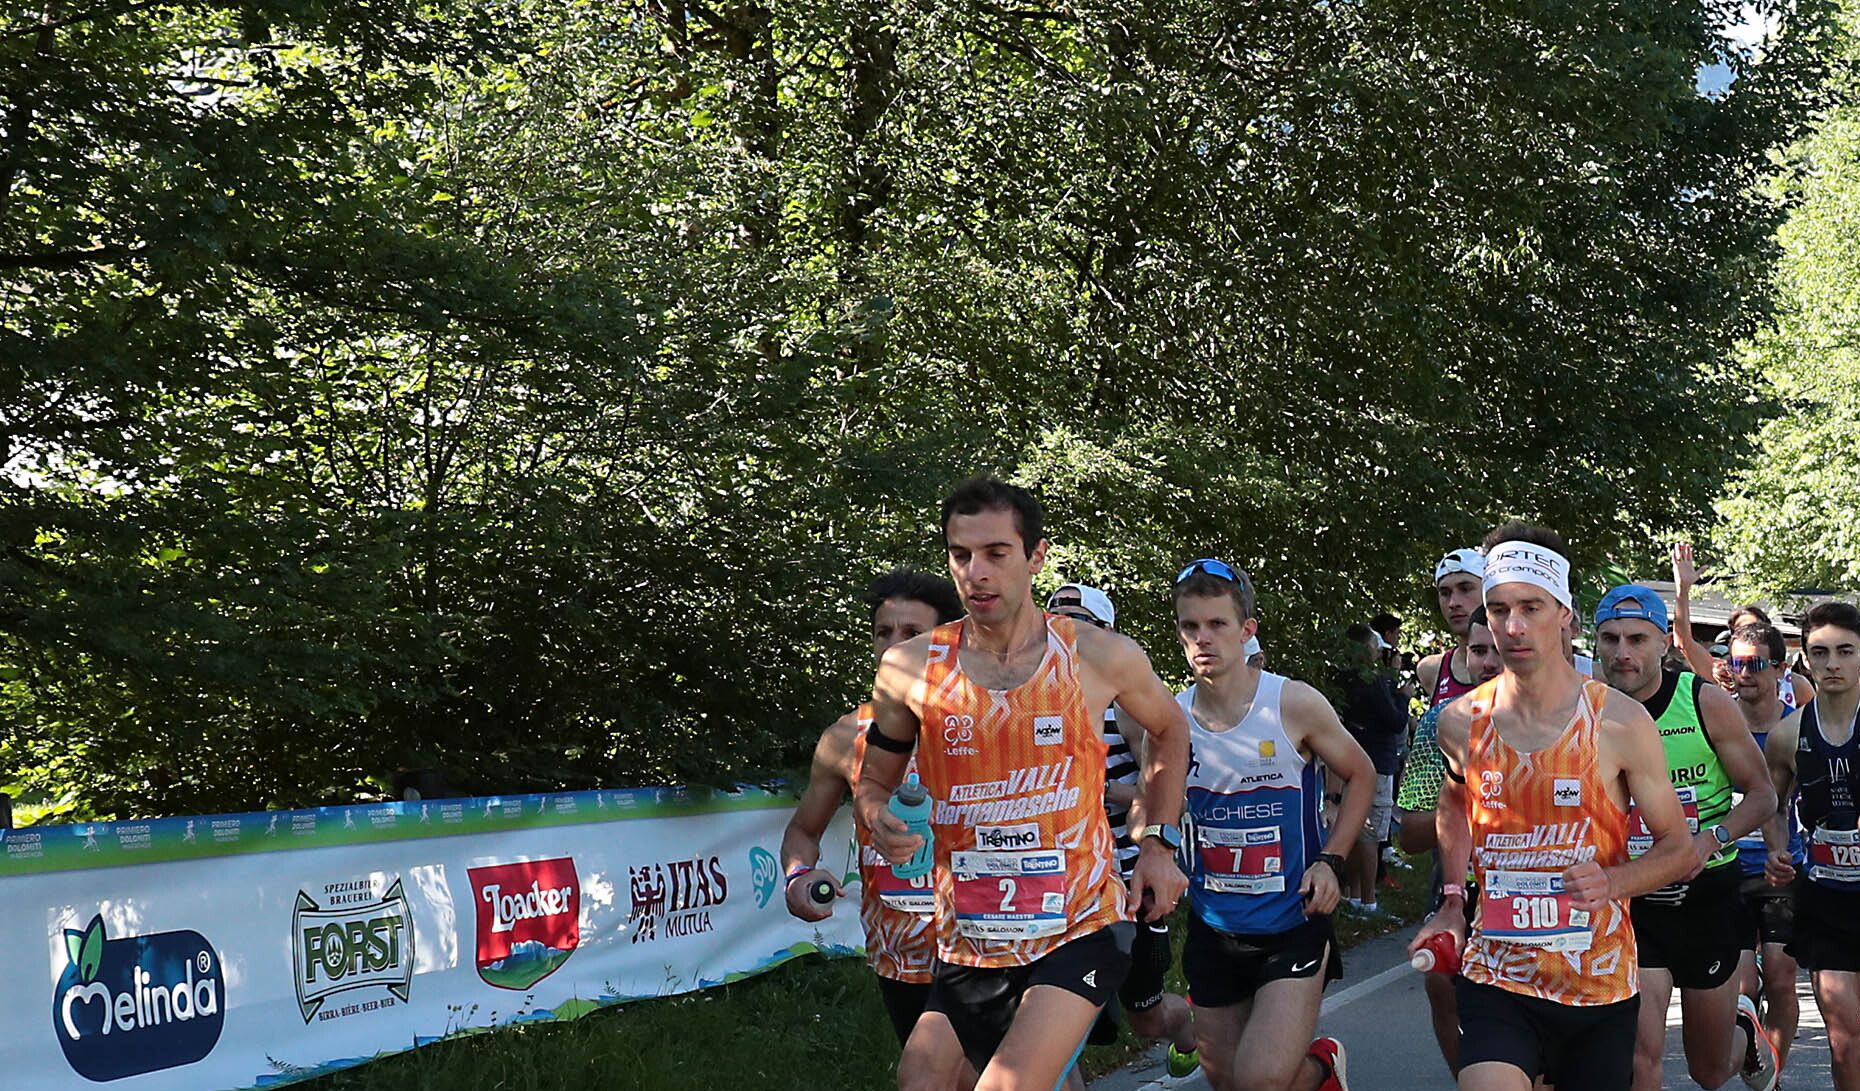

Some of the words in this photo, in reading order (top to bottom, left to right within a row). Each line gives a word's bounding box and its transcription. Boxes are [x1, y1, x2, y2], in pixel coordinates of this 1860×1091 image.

[951, 781, 1007, 802] ATLETICA
[1240, 773, 1283, 784] ATLETICA
[979, 829, 1035, 847] TRENTINO
[1229, 848, 1243, 872] 7
[330, 892, 373, 906] BRAUEREI
[667, 856, 728, 914] ITAS
[998, 878, 1016, 911] 2
[483, 879, 572, 934] Loacker
[1512, 896, 1559, 929] 310
[665, 911, 713, 940] MUTUA
[303, 915, 404, 984] FORST
